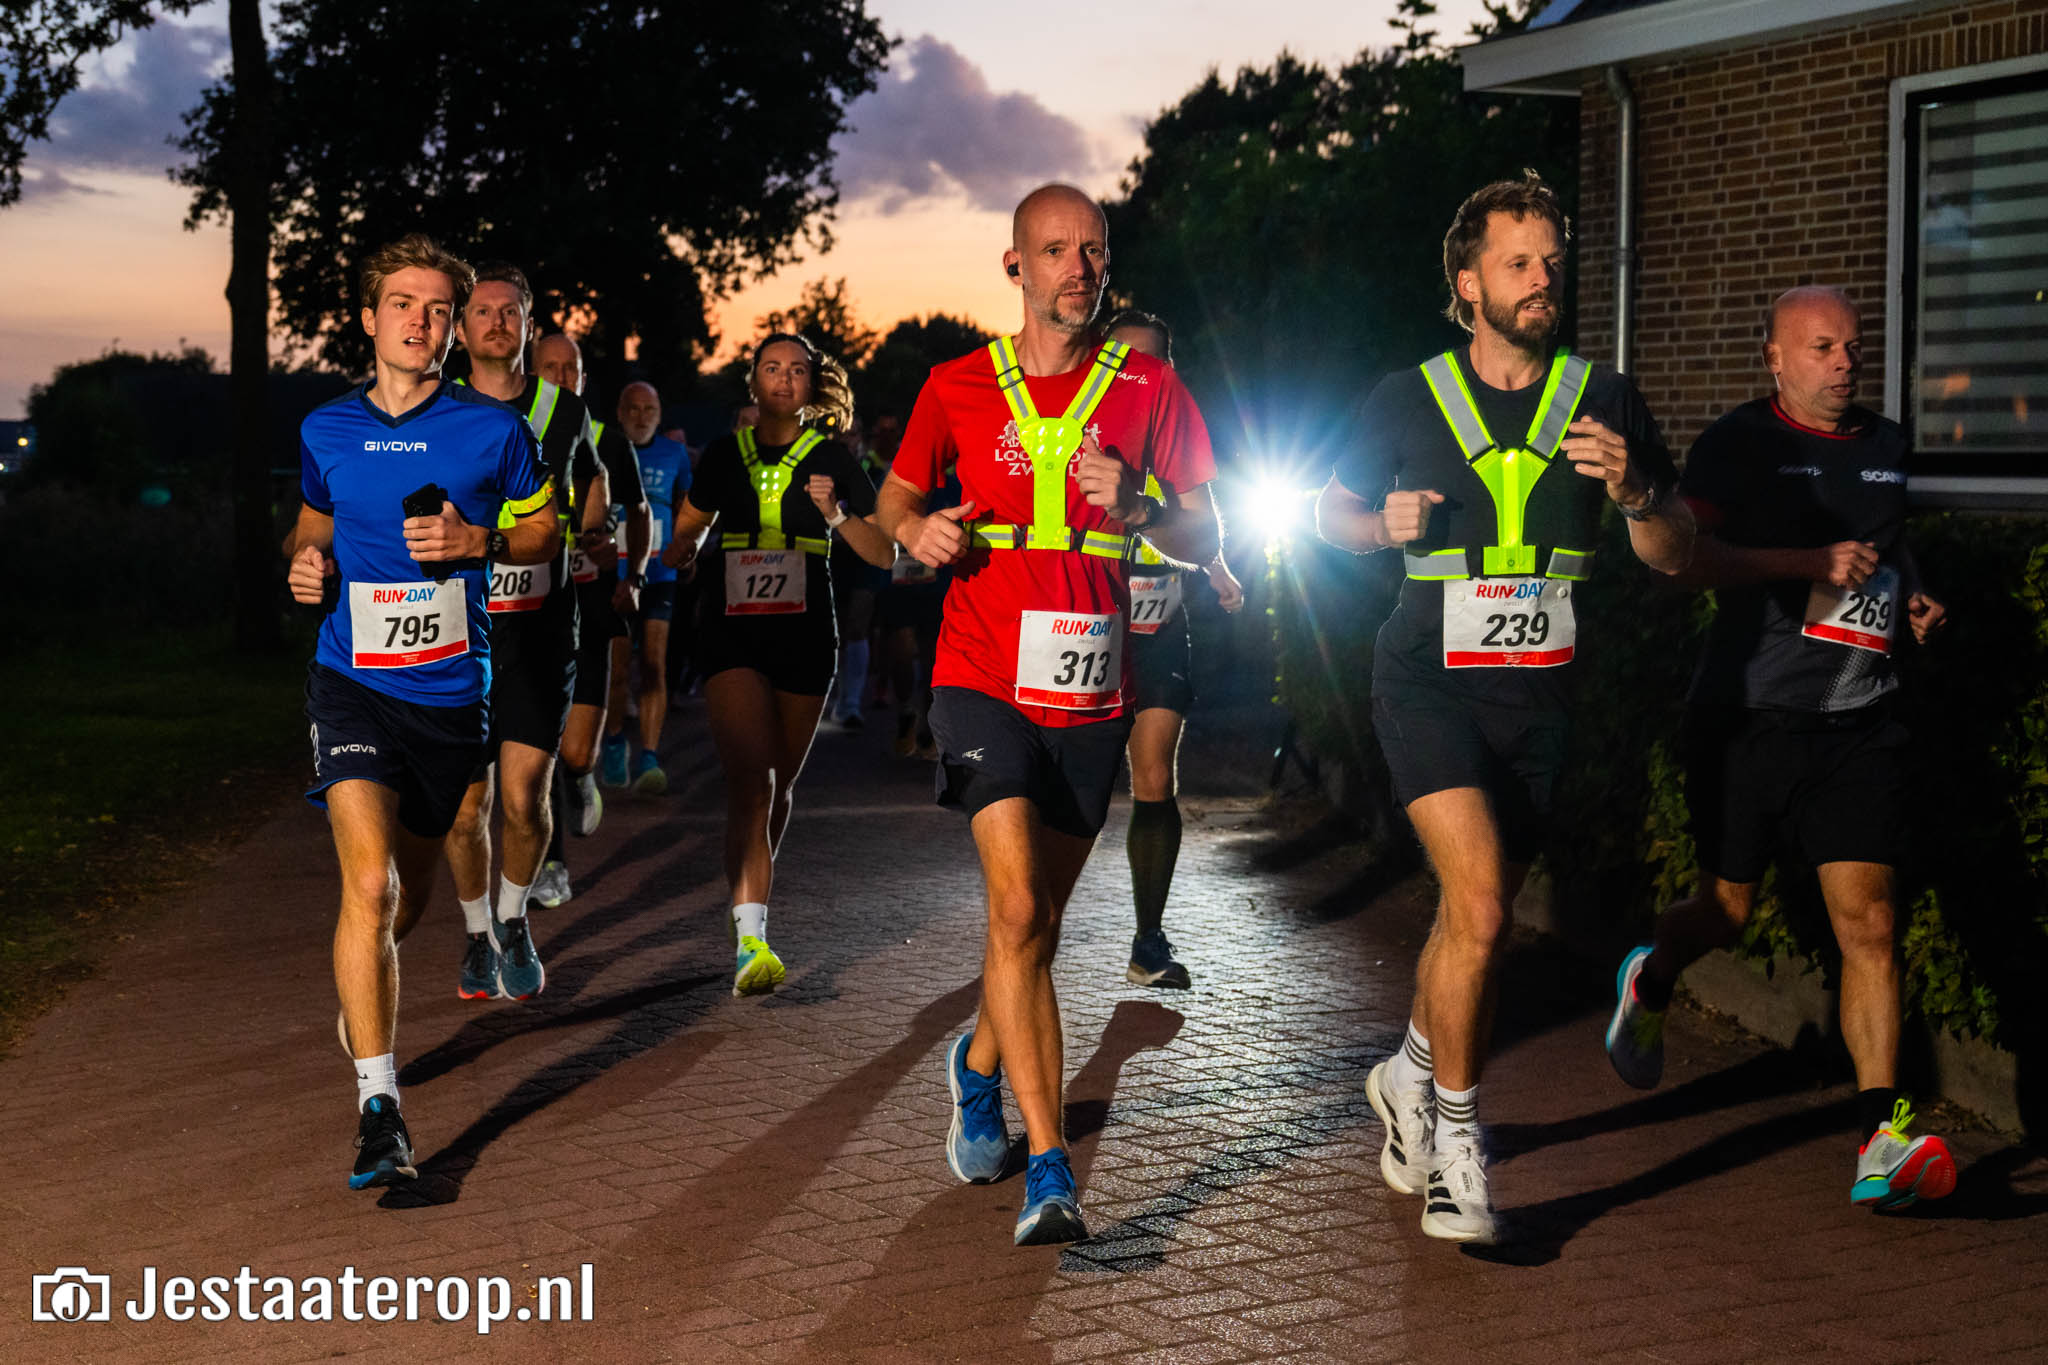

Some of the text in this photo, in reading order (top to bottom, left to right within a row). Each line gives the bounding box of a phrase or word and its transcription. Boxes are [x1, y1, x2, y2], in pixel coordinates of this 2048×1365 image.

[364, 441, 427, 452] GIVOVA
[490, 570, 532, 596] 208
[746, 574, 788, 598] 127
[1132, 598, 1168, 620] 171
[1839, 592, 1892, 631] 269
[385, 613, 440, 647] 795
[1480, 611, 1549, 646] 239
[1053, 650, 1110, 687] 313
[330, 744, 377, 756] GIVOVA
